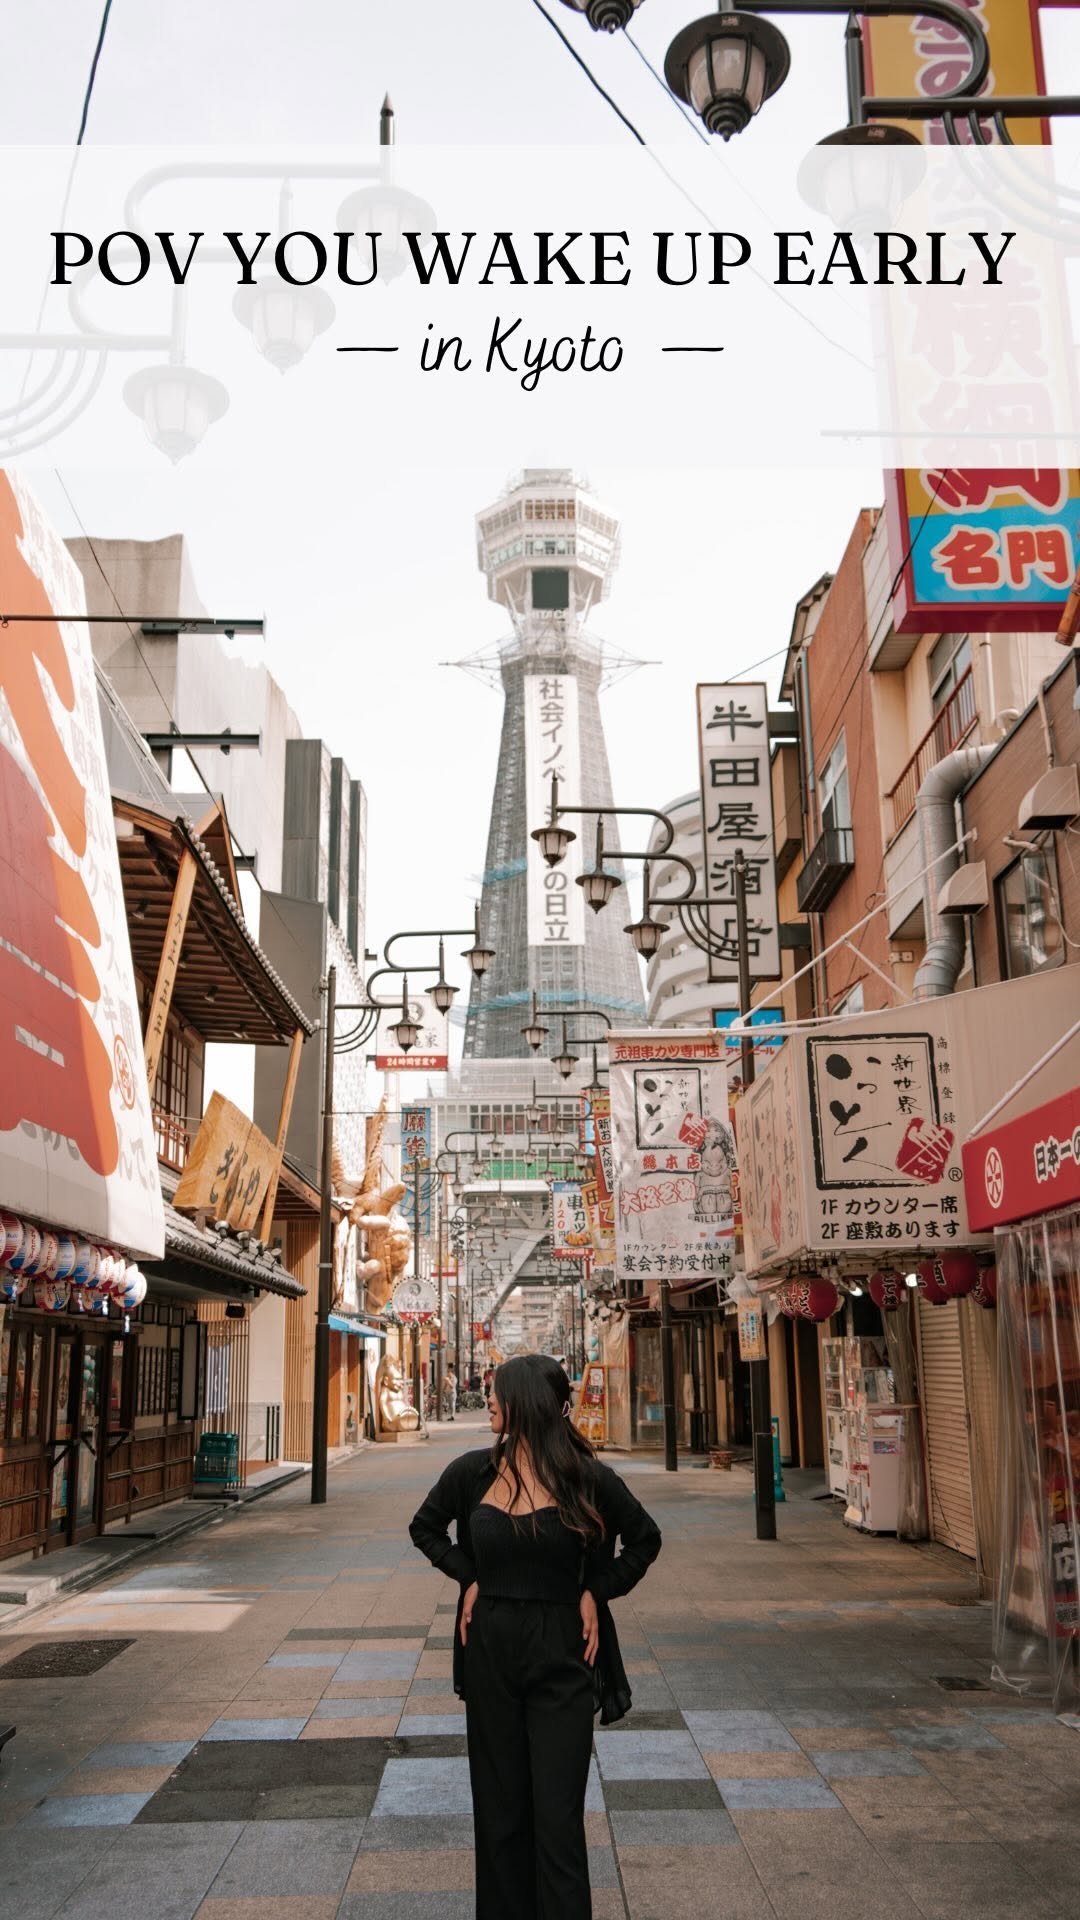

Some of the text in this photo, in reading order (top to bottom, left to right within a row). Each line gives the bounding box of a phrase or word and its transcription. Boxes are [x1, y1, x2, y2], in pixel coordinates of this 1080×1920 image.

[935, 527, 1071, 589] 名門
[615, 1044, 720, 1060] 元祖串カツ専門店
[891, 1054, 922, 1115] 新世界
[821, 1196, 958, 1215] 1F カウンター席
[821, 1220, 960, 1240] 2F 座敷あります
[623, 1254, 731, 1273] 宴会予約受付中
